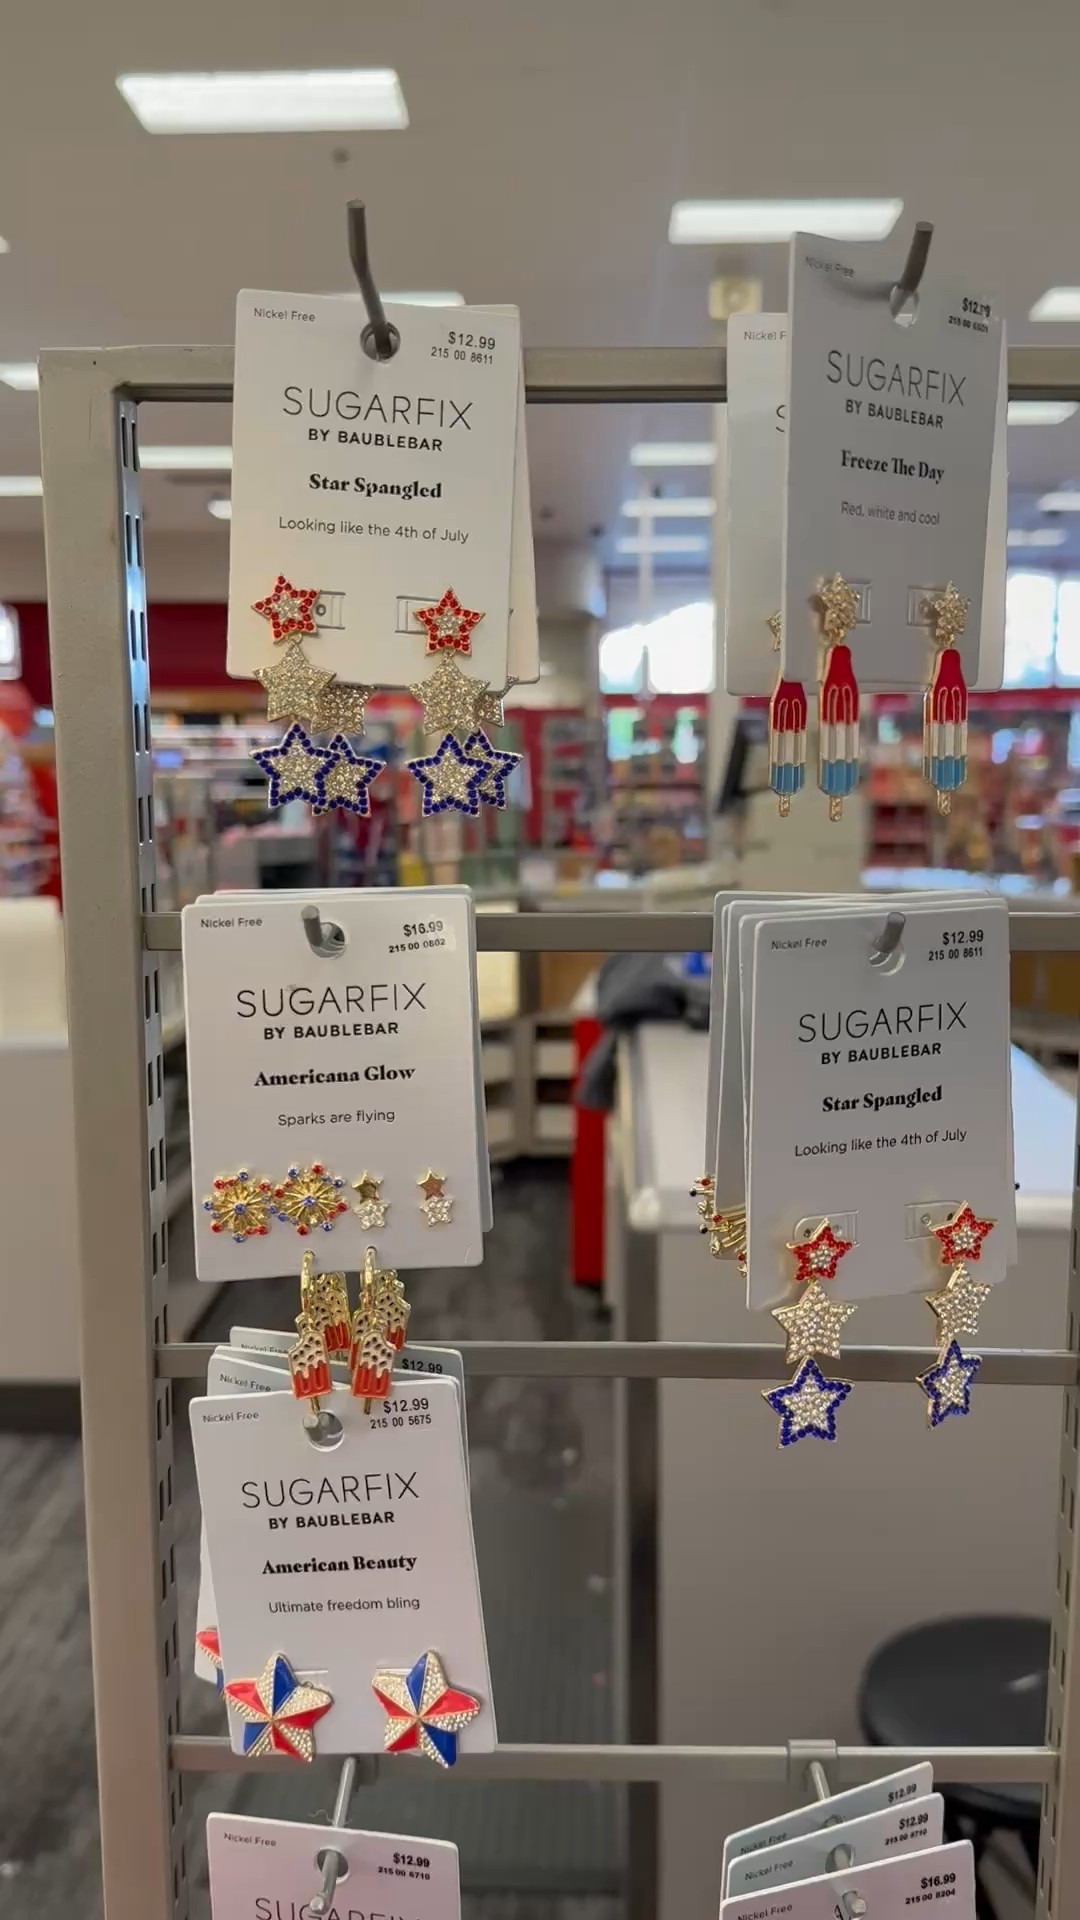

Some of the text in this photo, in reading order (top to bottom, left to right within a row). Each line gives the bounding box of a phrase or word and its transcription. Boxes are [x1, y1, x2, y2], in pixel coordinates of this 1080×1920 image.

[253, 308, 316, 322] Nickel Free
[448, 331, 496, 350] $12.99
[744, 331, 777, 341] Nickel
[431, 347, 494, 365] 215 00 8611
[826, 350, 966, 407] SUGARFIX
[283, 386, 473, 431] SUGARFIX
[845, 399, 944, 429] BY BAUBLEBAR
[308, 428, 443, 452] BY BAUBLEBAR
[841, 449, 945, 484] Freeze The Day
[309, 473, 442, 500] Star Spangled
[841, 501, 940, 525] Red, white and cool
[279, 516, 469, 544] Looking like the 4th of July
[200, 917, 263, 928] Nickel Free
[403, 920, 443, 937] $16.99
[771, 937, 828, 950] Nickel Free
[943, 929, 984, 946] $12.99
[389, 944, 406, 953] 215
[408, 942, 420, 950] 00
[929, 947, 983, 961] 215 00 8611
[237, 983, 427, 1018] SUGARFIX
[798, 1001, 967, 1043] SUGARFIX
[264, 1022, 399, 1040] BY BAUBLEBAR
[821, 1043, 942, 1065] BY BAUBLEBAR
[254, 1065, 416, 1087] Americana Glow
[822, 1085, 943, 1112] Star Spangled
[278, 1109, 396, 1128] Sparks are flying
[795, 1128, 967, 1157] Looking like the 4th of July
[402, 1359, 443, 1374] $12.99
[250, 1380, 271, 1392] Free
[383, 1398, 429, 1414] $12.99
[203, 1411, 260, 1423] Nickel Free
[370, 1415, 432, 1429] 215 00 5675
[241, 1472, 420, 1509] SUGARFIX
[269, 1512, 395, 1529] BY BAUBLEBAR
[262, 1556, 417, 1575] American Beauty
[269, 1597, 420, 1614] Ultimate freedom bling
[899, 1813, 928, 1830] $12.99
[224, 1833, 252, 1844] Nickel
[393, 1852, 430, 1868] $12.99
[378, 1866, 394, 1875] 215
[921, 1872, 956, 1889] $16.99
[905, 1896, 920, 1905] 215
[922, 1893, 932, 1902] 00
